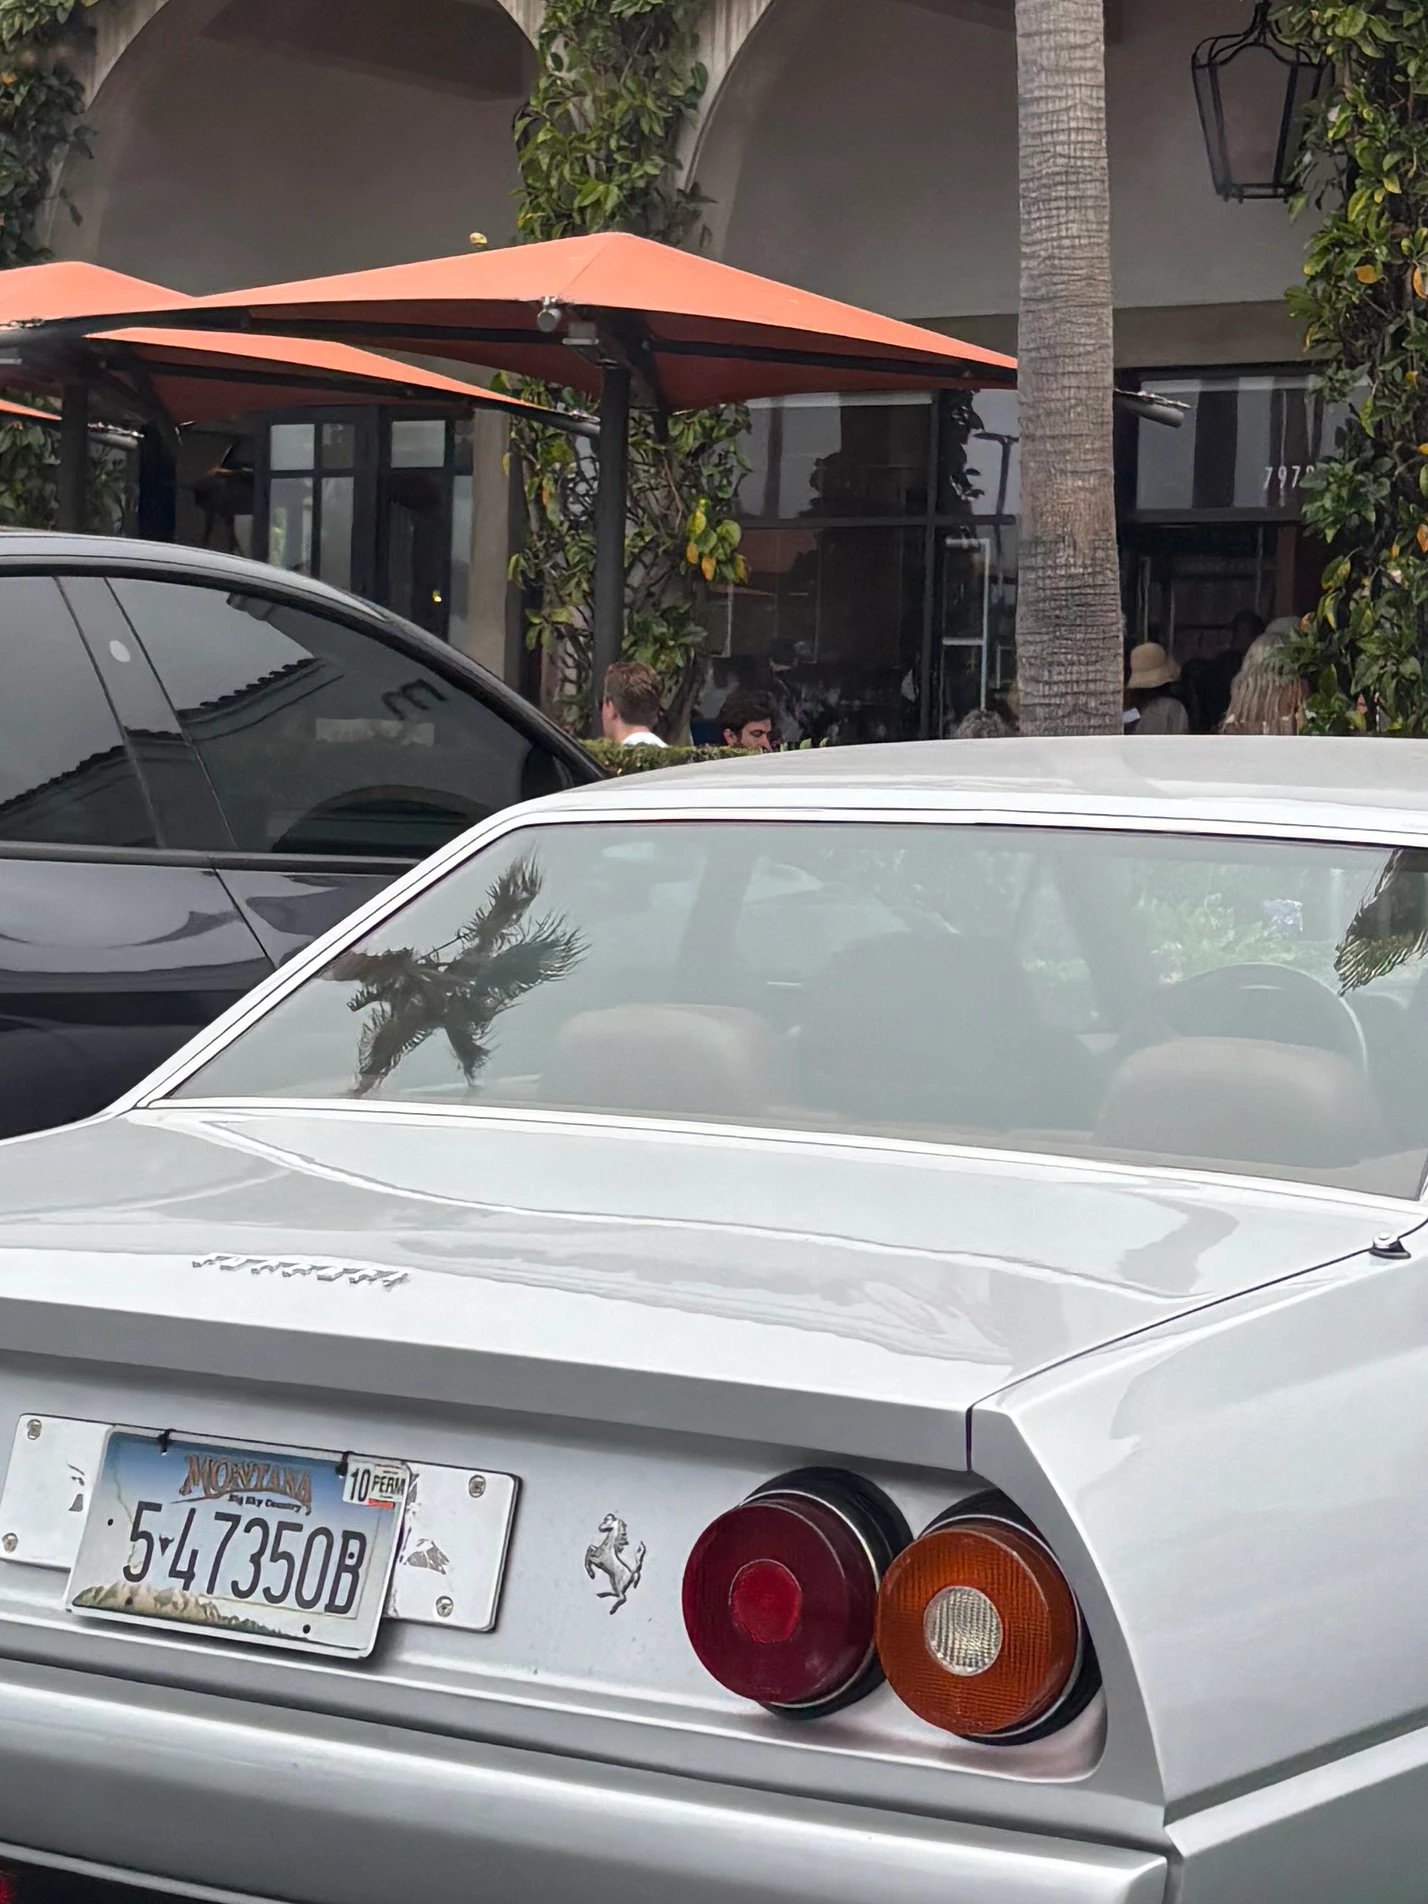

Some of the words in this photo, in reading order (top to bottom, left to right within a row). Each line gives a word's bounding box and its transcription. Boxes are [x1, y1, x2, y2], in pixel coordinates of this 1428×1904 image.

[179, 1454, 313, 1516] MONTANA
[350, 1468, 371, 1502] 10
[372, 1475, 406, 1496] PERM
